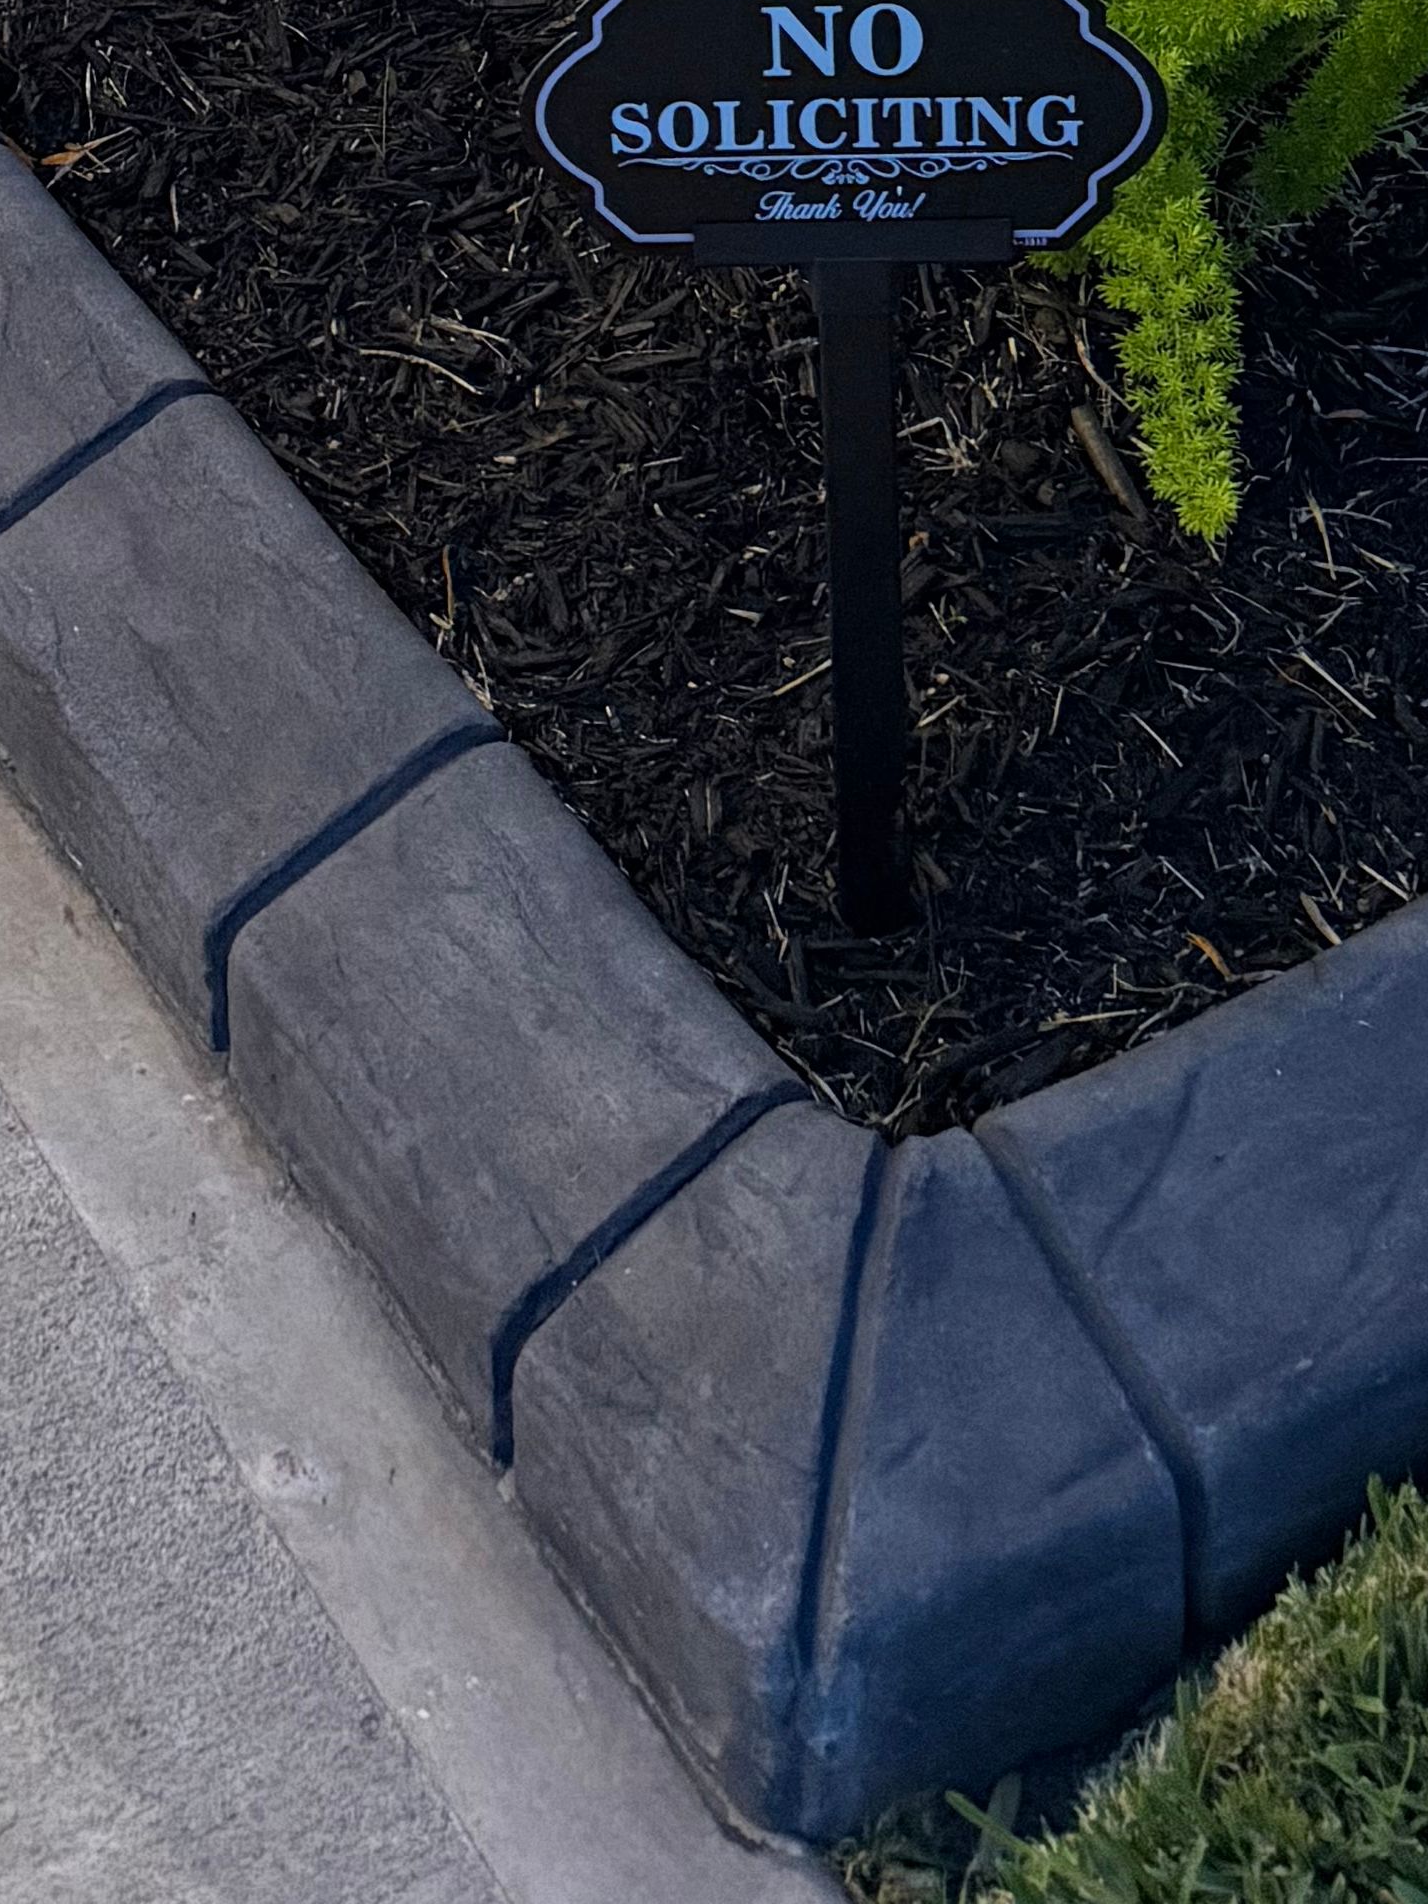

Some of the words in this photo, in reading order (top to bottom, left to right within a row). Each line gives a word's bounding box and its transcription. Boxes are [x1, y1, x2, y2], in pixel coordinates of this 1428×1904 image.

[760, 2, 924, 78] NO
[610, 94, 1084, 155] SOLICITING
[754, 191, 843, 221] Thank
[852, 189, 926, 222] You!
